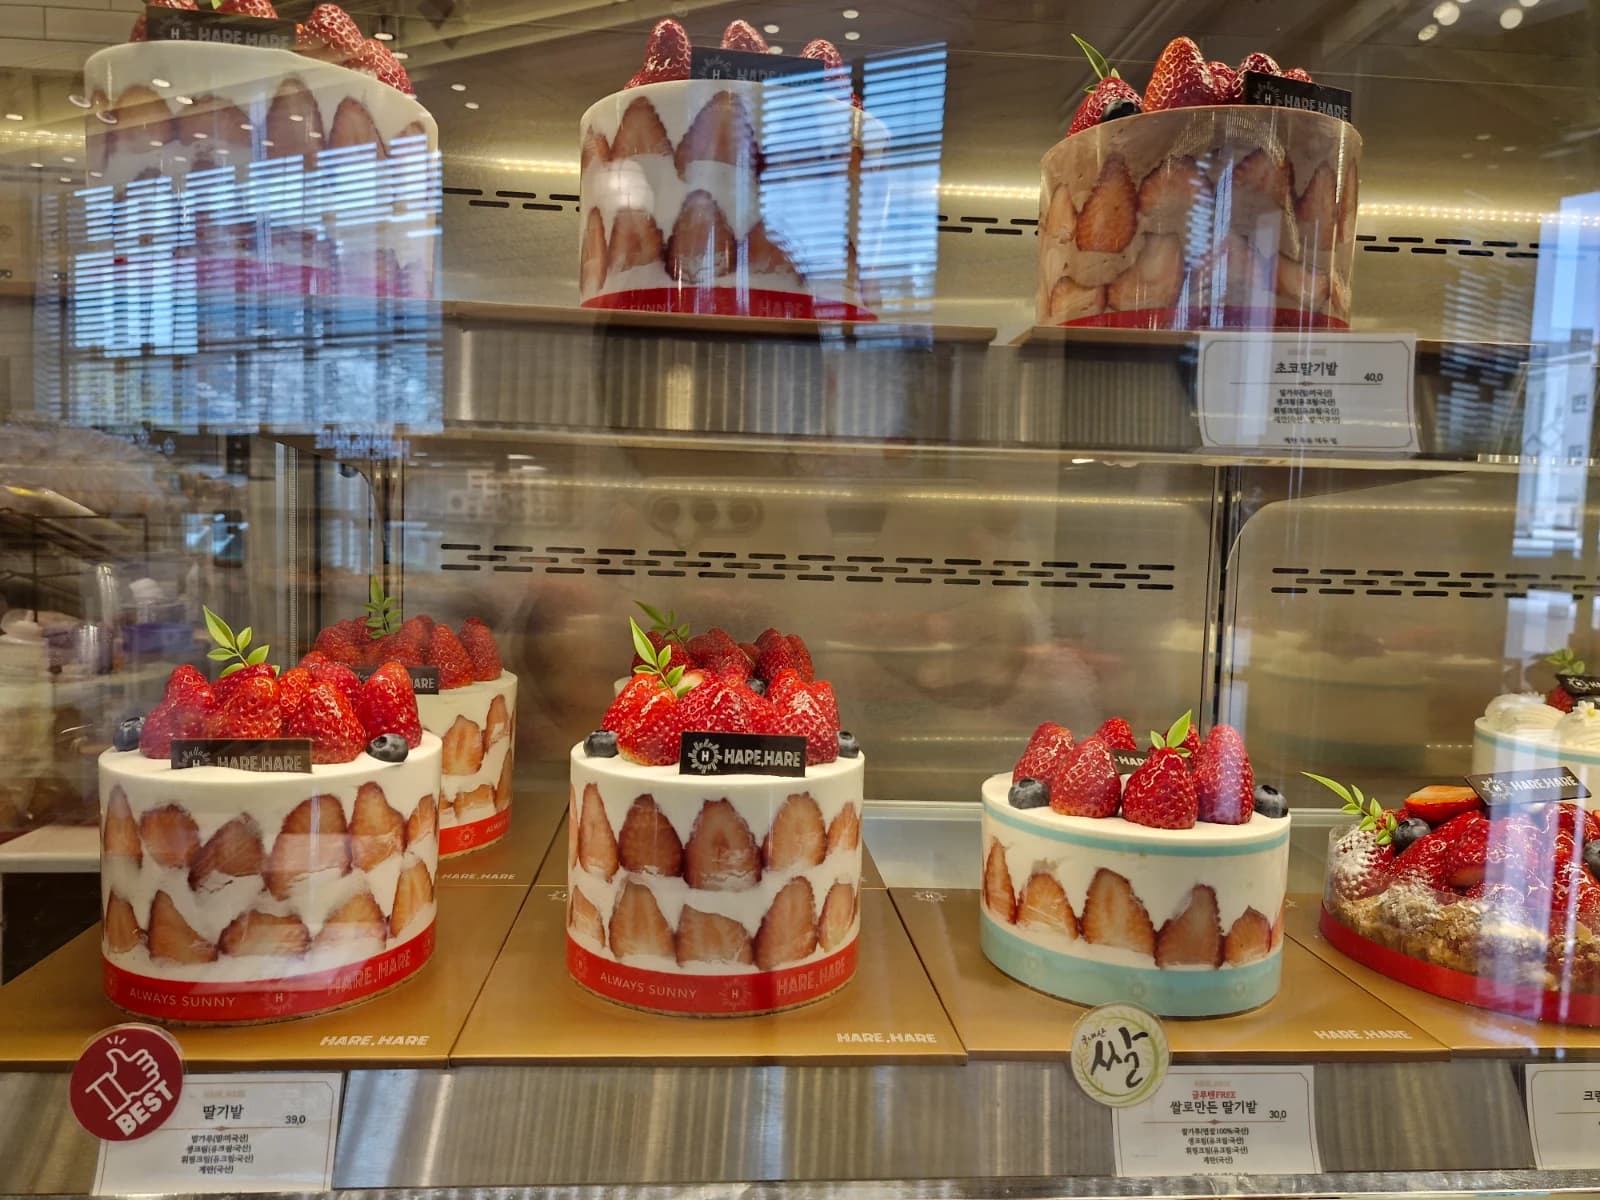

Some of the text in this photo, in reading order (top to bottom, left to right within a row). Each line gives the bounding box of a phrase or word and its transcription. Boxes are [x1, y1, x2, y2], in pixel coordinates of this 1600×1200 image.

[1275, 361, 1338, 377] 초코딸기밭
[600, 971, 645, 993] ALWAYS
[648, 984, 698, 999] SUNNY
[129, 987, 177, 1006] ALWAYS
[181, 995, 236, 1008] SUNNY
[1089, 1026, 1149, 1089] 쌀
[115, 1080, 175, 1137] BEST
[202, 1104, 244, 1121] 딸기밭
[1169, 1100, 1258, 1115] 쌀로만든 딸기밭
